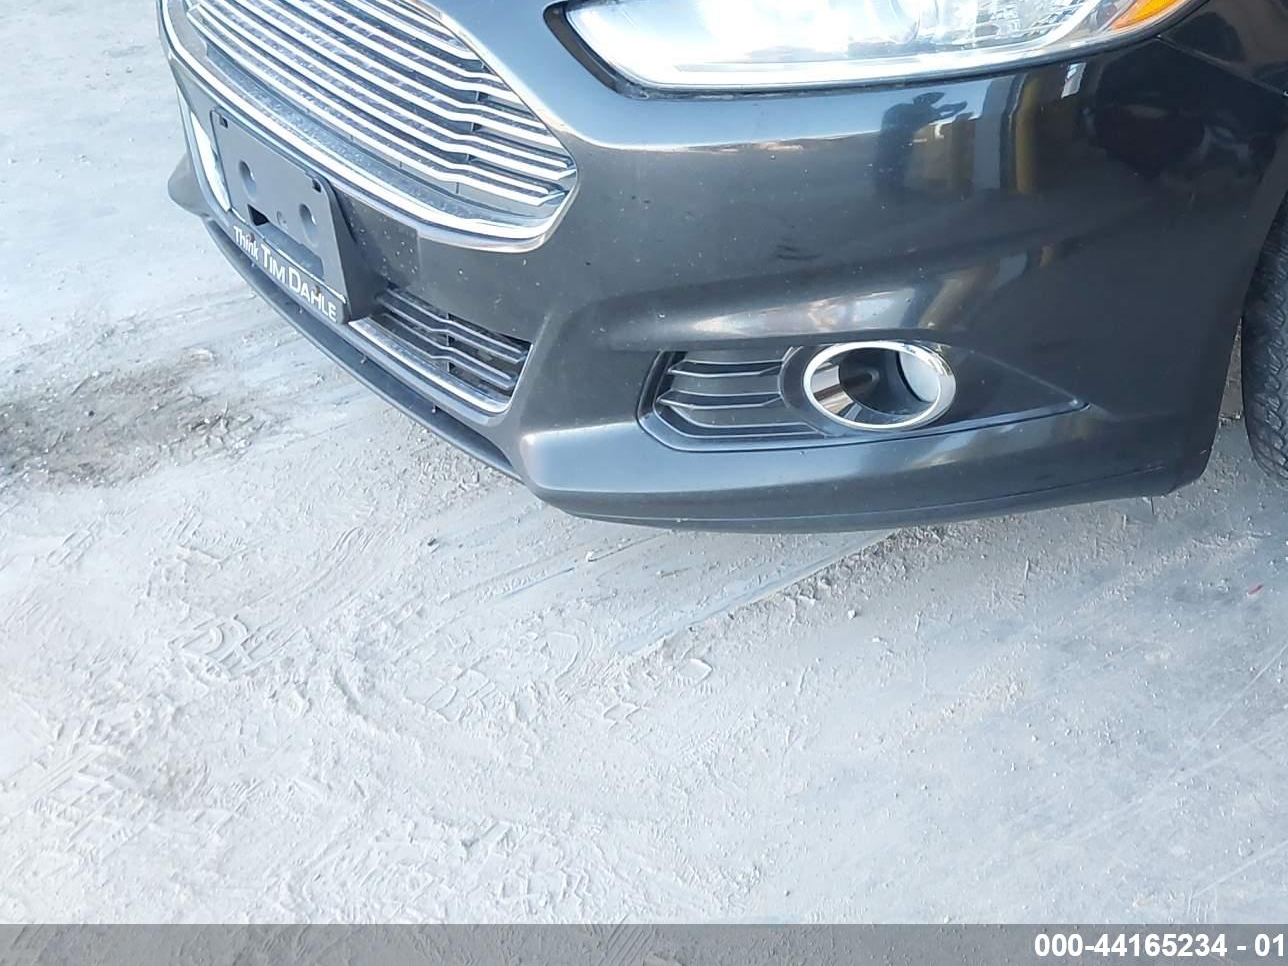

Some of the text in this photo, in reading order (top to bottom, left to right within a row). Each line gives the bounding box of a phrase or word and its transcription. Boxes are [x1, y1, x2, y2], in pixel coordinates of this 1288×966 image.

[233, 225, 337, 323] Think TIM DAHLE
